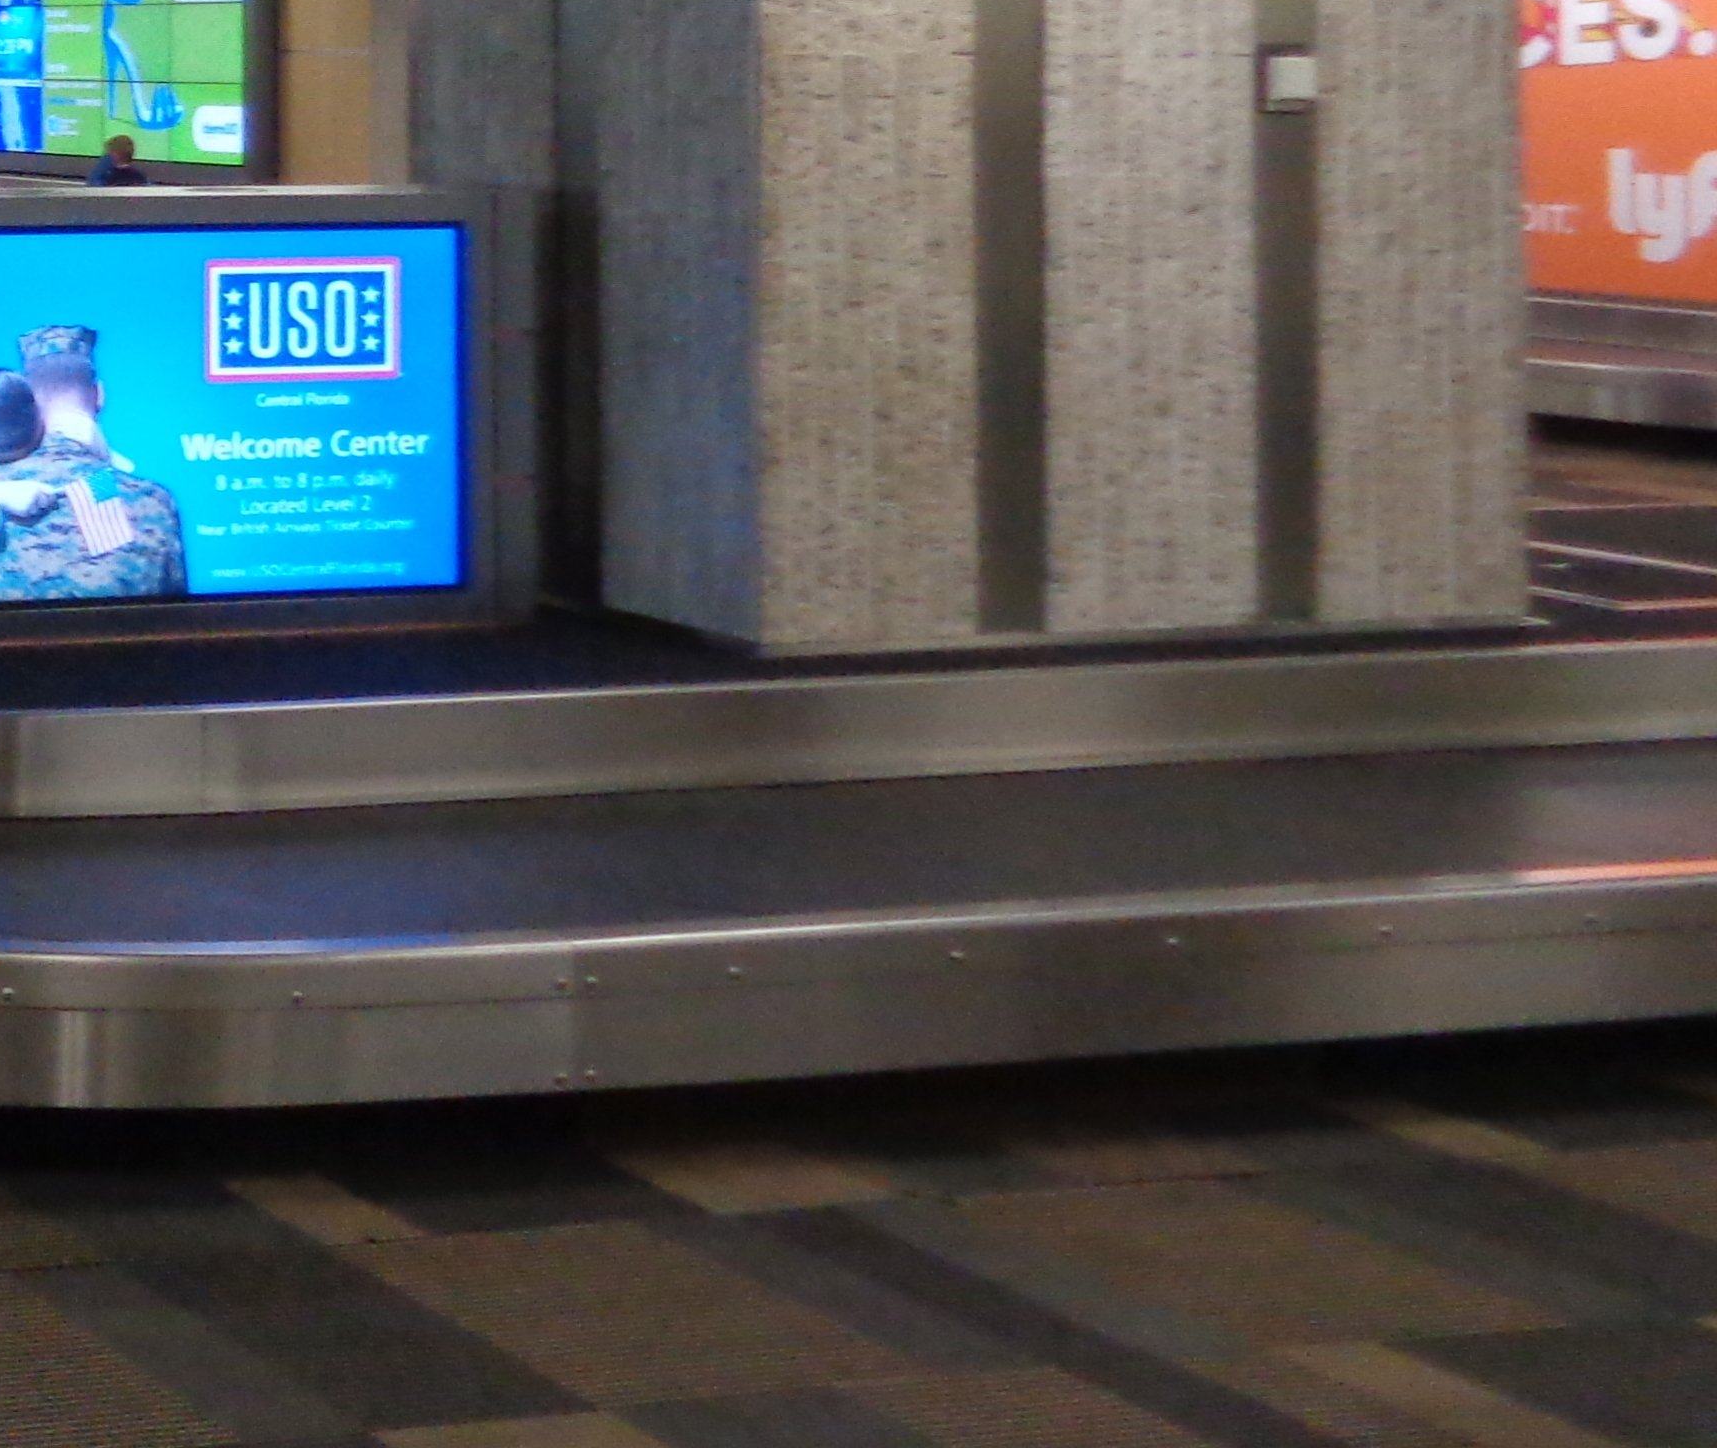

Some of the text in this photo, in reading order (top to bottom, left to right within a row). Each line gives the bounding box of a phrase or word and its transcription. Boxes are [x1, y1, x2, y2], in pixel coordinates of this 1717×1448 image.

[249, 280, 357, 359] USO
[255, 392, 351, 407] Central Florida
[180, 429, 430, 461] Welcome Center
[215, 474, 227, 491] 8
[231, 476, 269, 490] a.m.
[273, 475, 293, 489] to
[297, 472, 308, 488] 8
[354, 470, 395, 490] daily
[240, 495, 372, 515] Located Level 2
